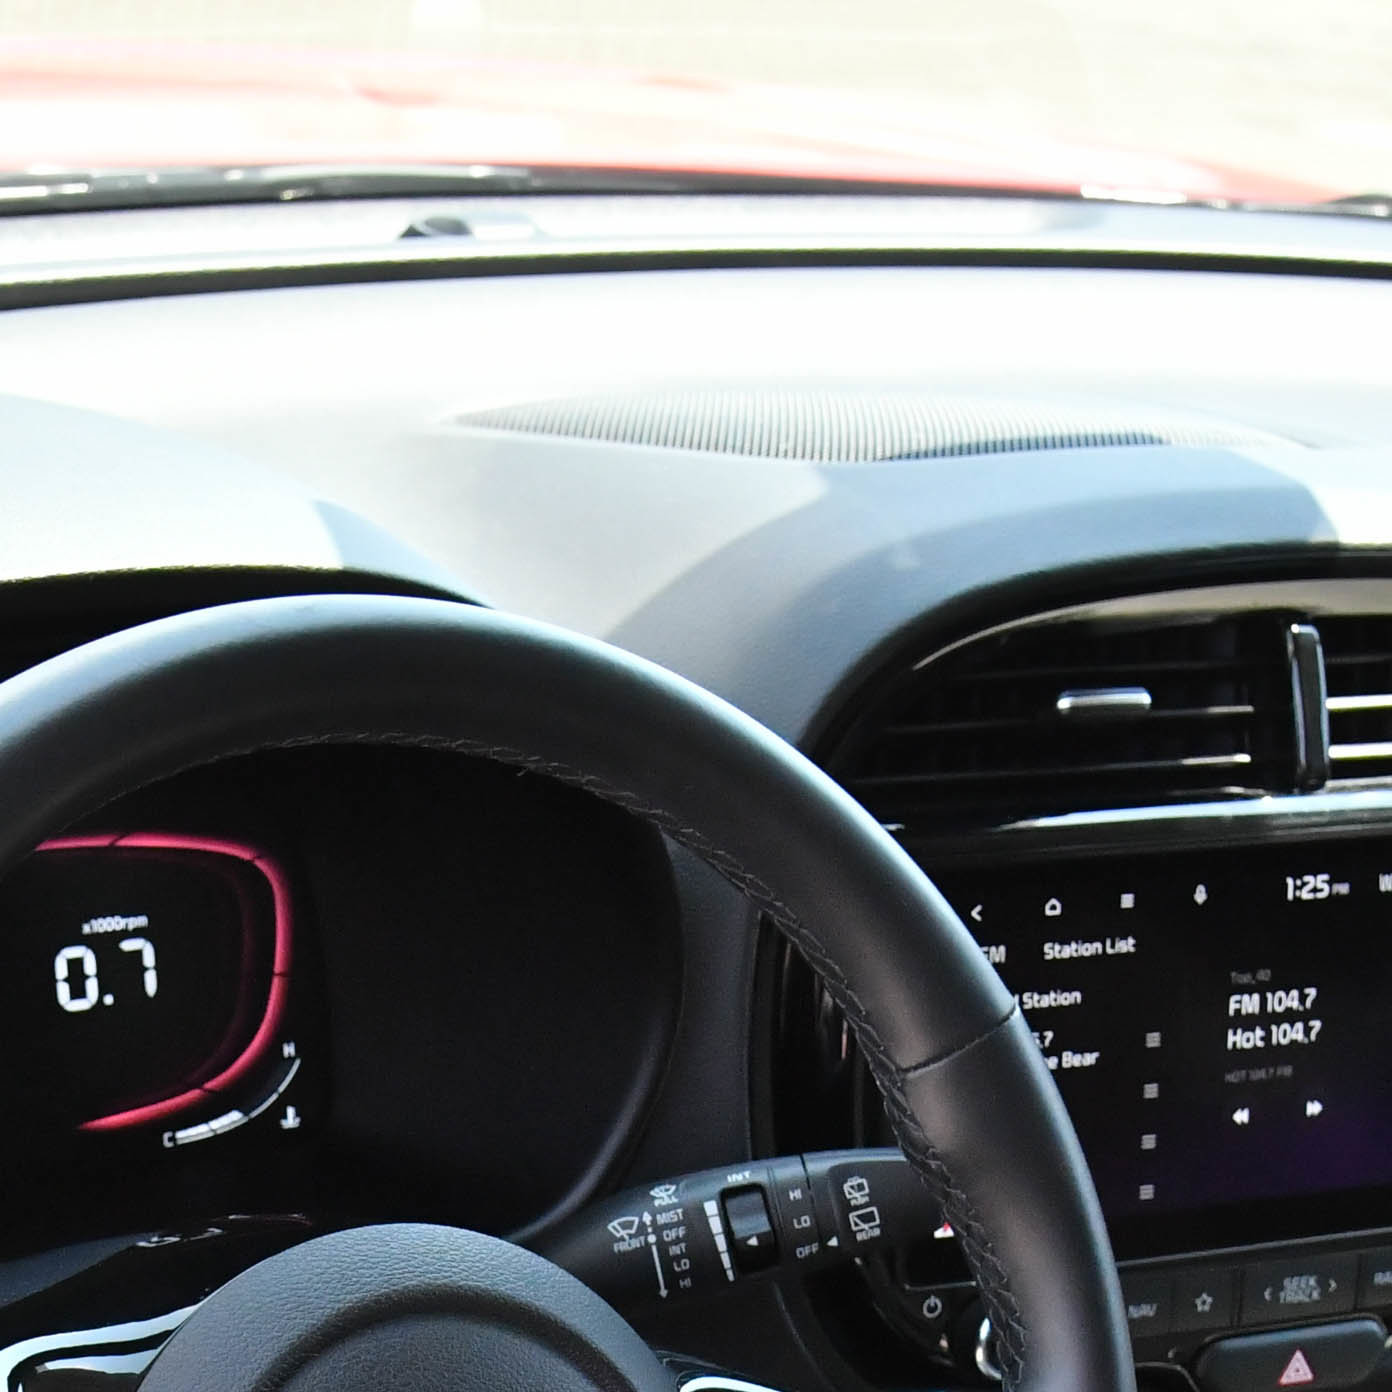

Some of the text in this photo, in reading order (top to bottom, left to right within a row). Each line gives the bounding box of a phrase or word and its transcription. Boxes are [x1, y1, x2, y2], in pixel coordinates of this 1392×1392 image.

[1286, 873, 1330, 901] 1:25
[1043, 939, 1103, 960] Station
[1106, 935, 1136, 955] List
[54, 937, 158, 1012] 0.7
[1022, 989, 1082, 1010] Station
[1229, 987, 1317, 1016] FM 104.7
[1227, 1020, 1322, 1050] Hot 104.7
[1062, 1051, 1100, 1069] Bear
[789, 1189, 802, 1201] HI
[656, 1208, 684, 1225] MIST
[793, 1215, 811, 1230] LO
[663, 1226, 686, 1242] OFF
[669, 1242, 687, 1257] INT
[796, 1243, 819, 1259] OFF
[673, 1259, 690, 1272] LO
[679, 1278, 692, 1289] HI
